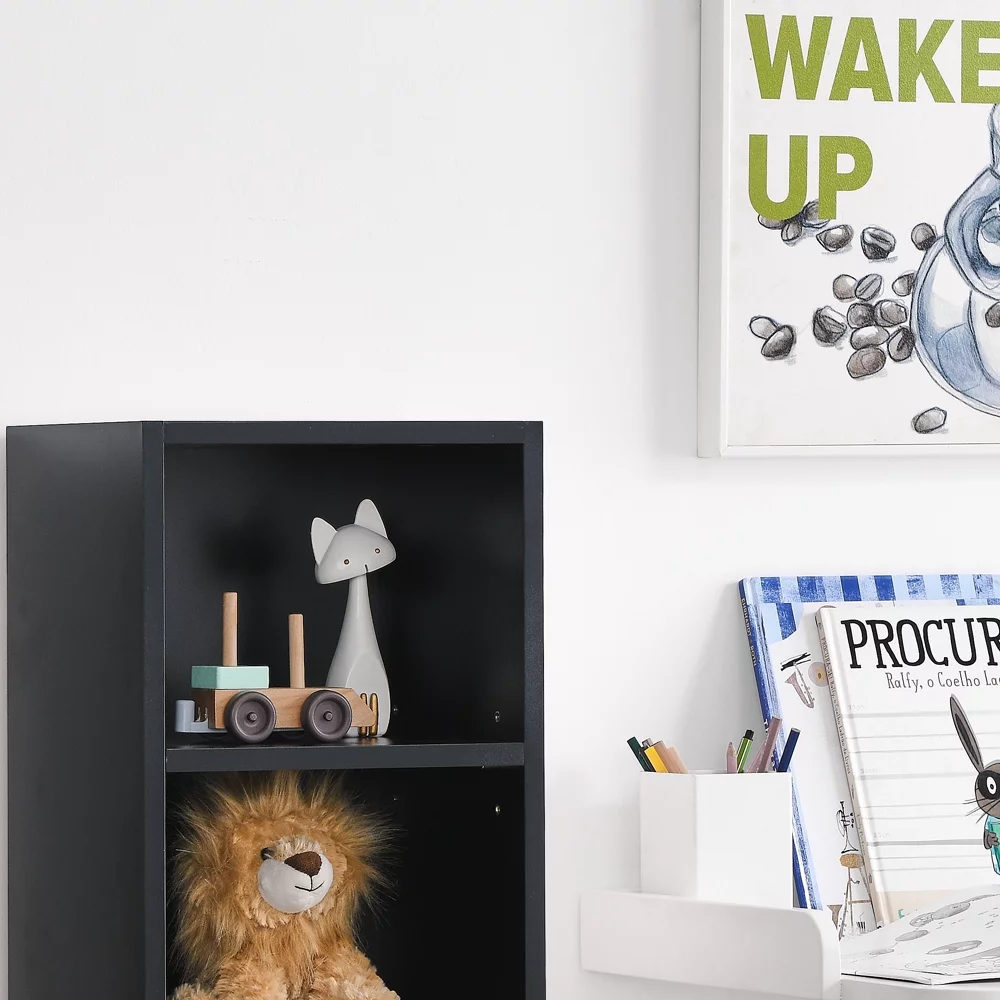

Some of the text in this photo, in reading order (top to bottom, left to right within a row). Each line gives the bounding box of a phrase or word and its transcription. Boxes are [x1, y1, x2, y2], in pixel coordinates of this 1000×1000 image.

[744, 13, 1000, 104] WAKE
[747, 133, 874, 221] UP
[840, 617, 1000, 669] PROCUR
[885, 670, 1000, 693] Ralfy, o Coelho La
